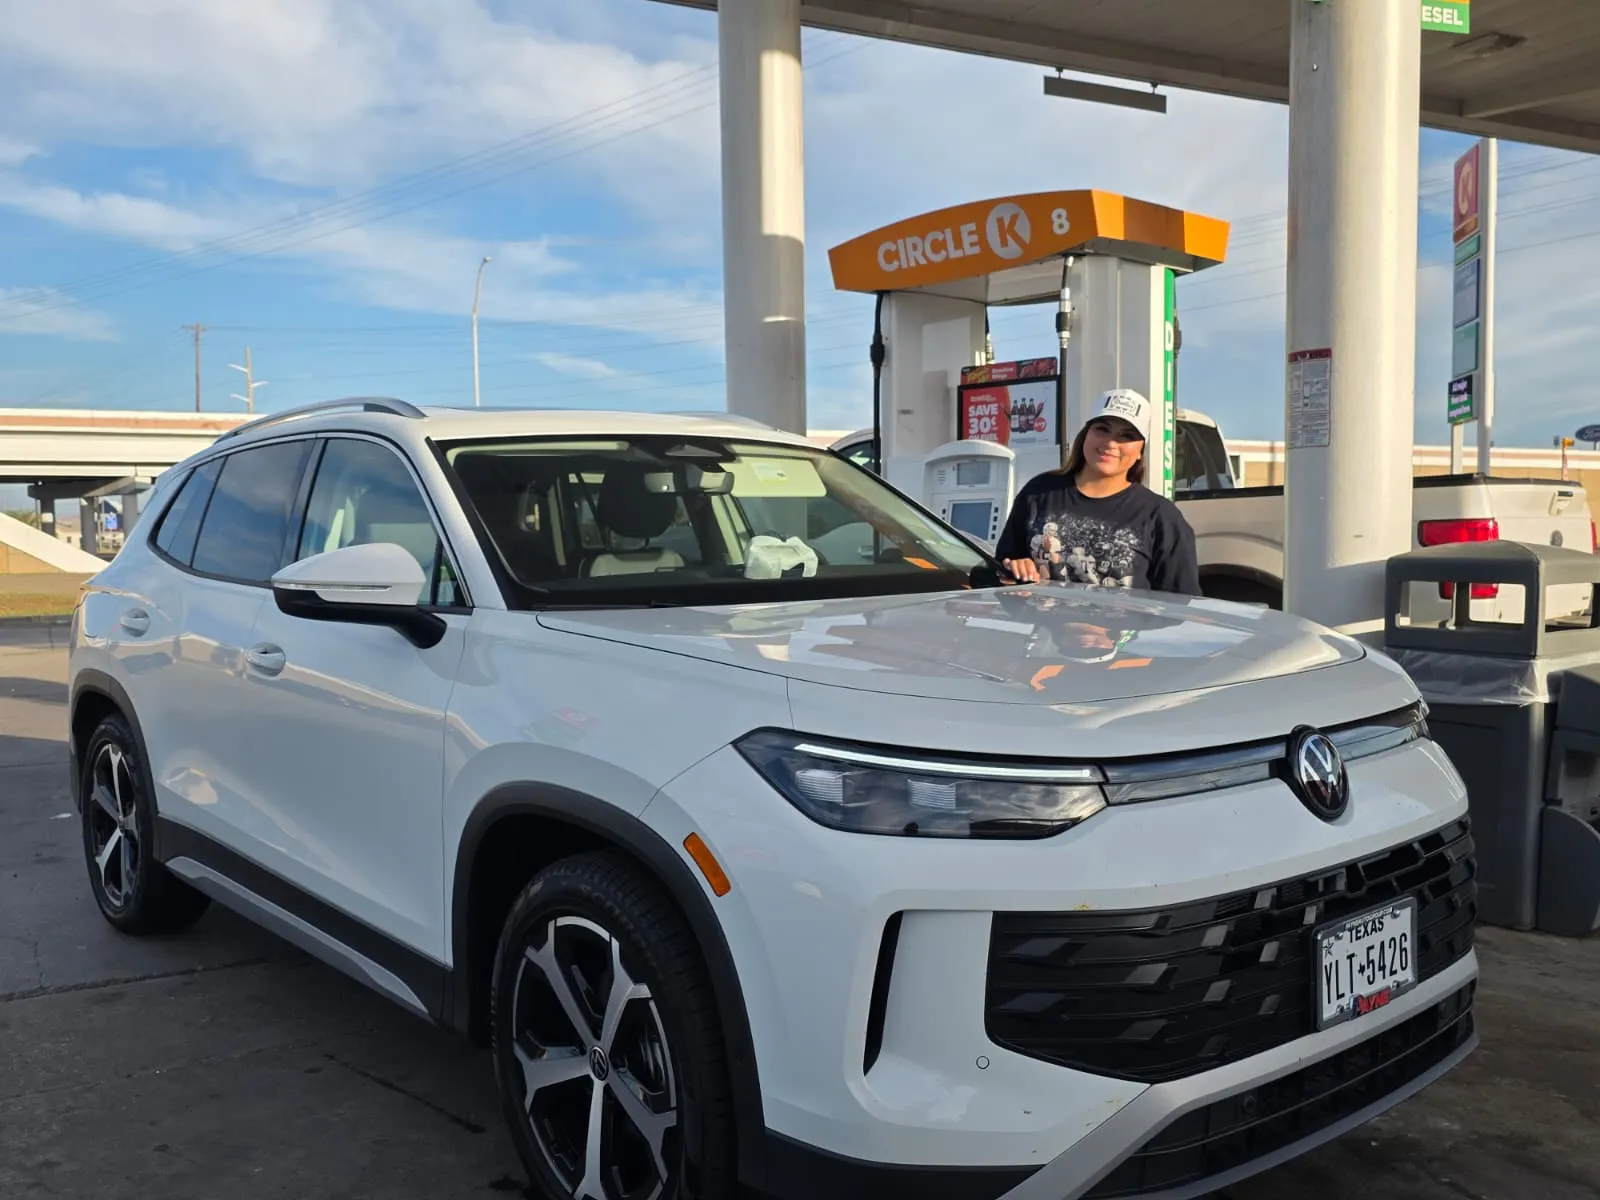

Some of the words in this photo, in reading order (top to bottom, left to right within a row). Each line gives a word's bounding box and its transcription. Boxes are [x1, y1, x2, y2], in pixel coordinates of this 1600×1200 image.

[1051, 208, 1070, 235] 8
[877, 222, 981, 272] CIRCLE
[994, 209, 1030, 253] K
[968, 403, 998, 417] SAVE
[1348, 917, 1384, 943] TEXAS
